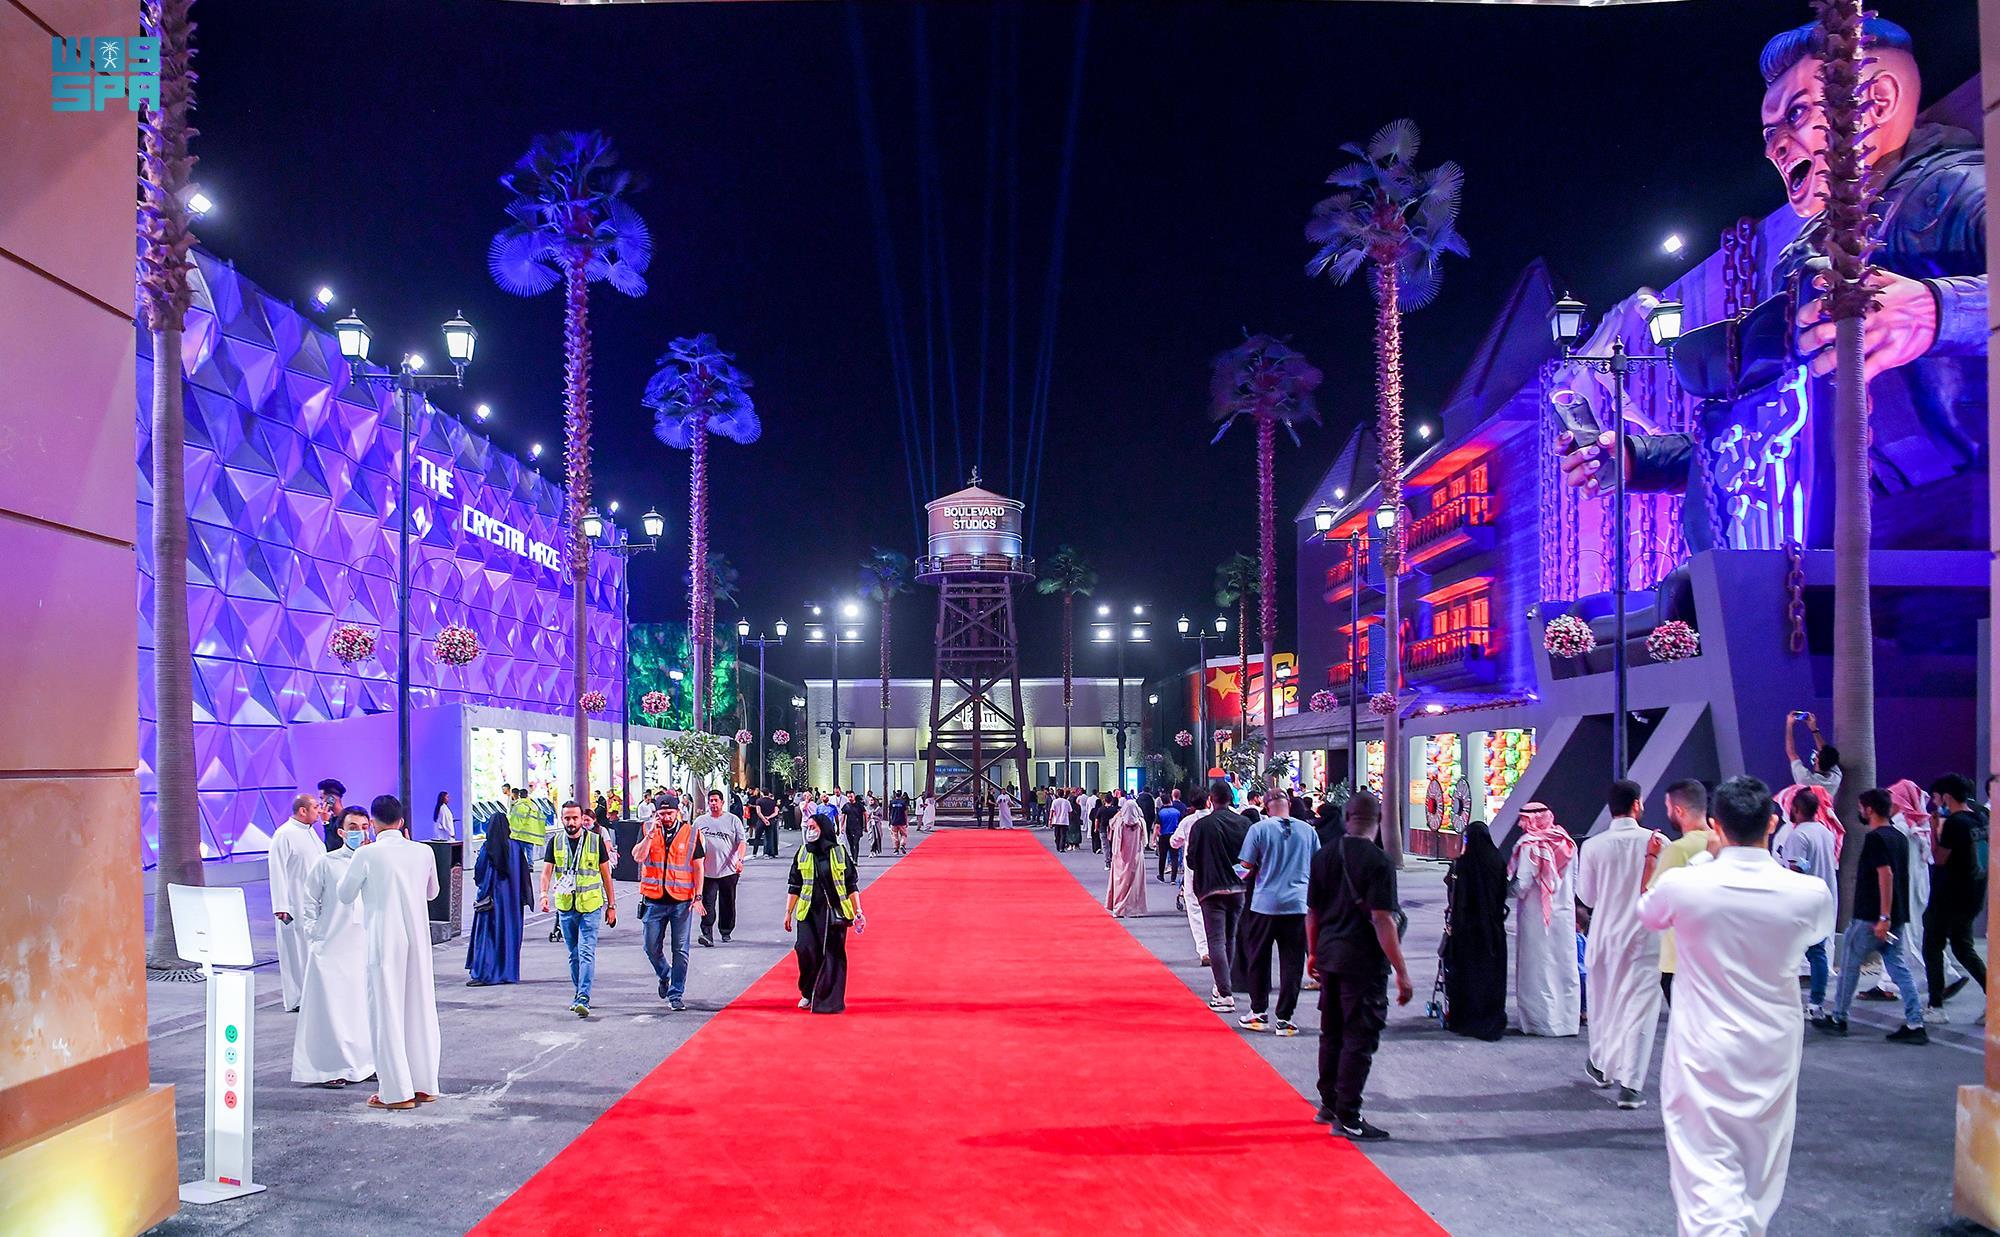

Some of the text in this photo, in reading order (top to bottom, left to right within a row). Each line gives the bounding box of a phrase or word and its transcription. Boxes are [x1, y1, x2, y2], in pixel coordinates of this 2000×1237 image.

[416, 455, 454, 500] THE
[944, 507, 1005, 516] BOULEVARD
[953, 520, 996, 529] STUDIOS
[462, 504, 561, 572] CRYSTAL MAZE
